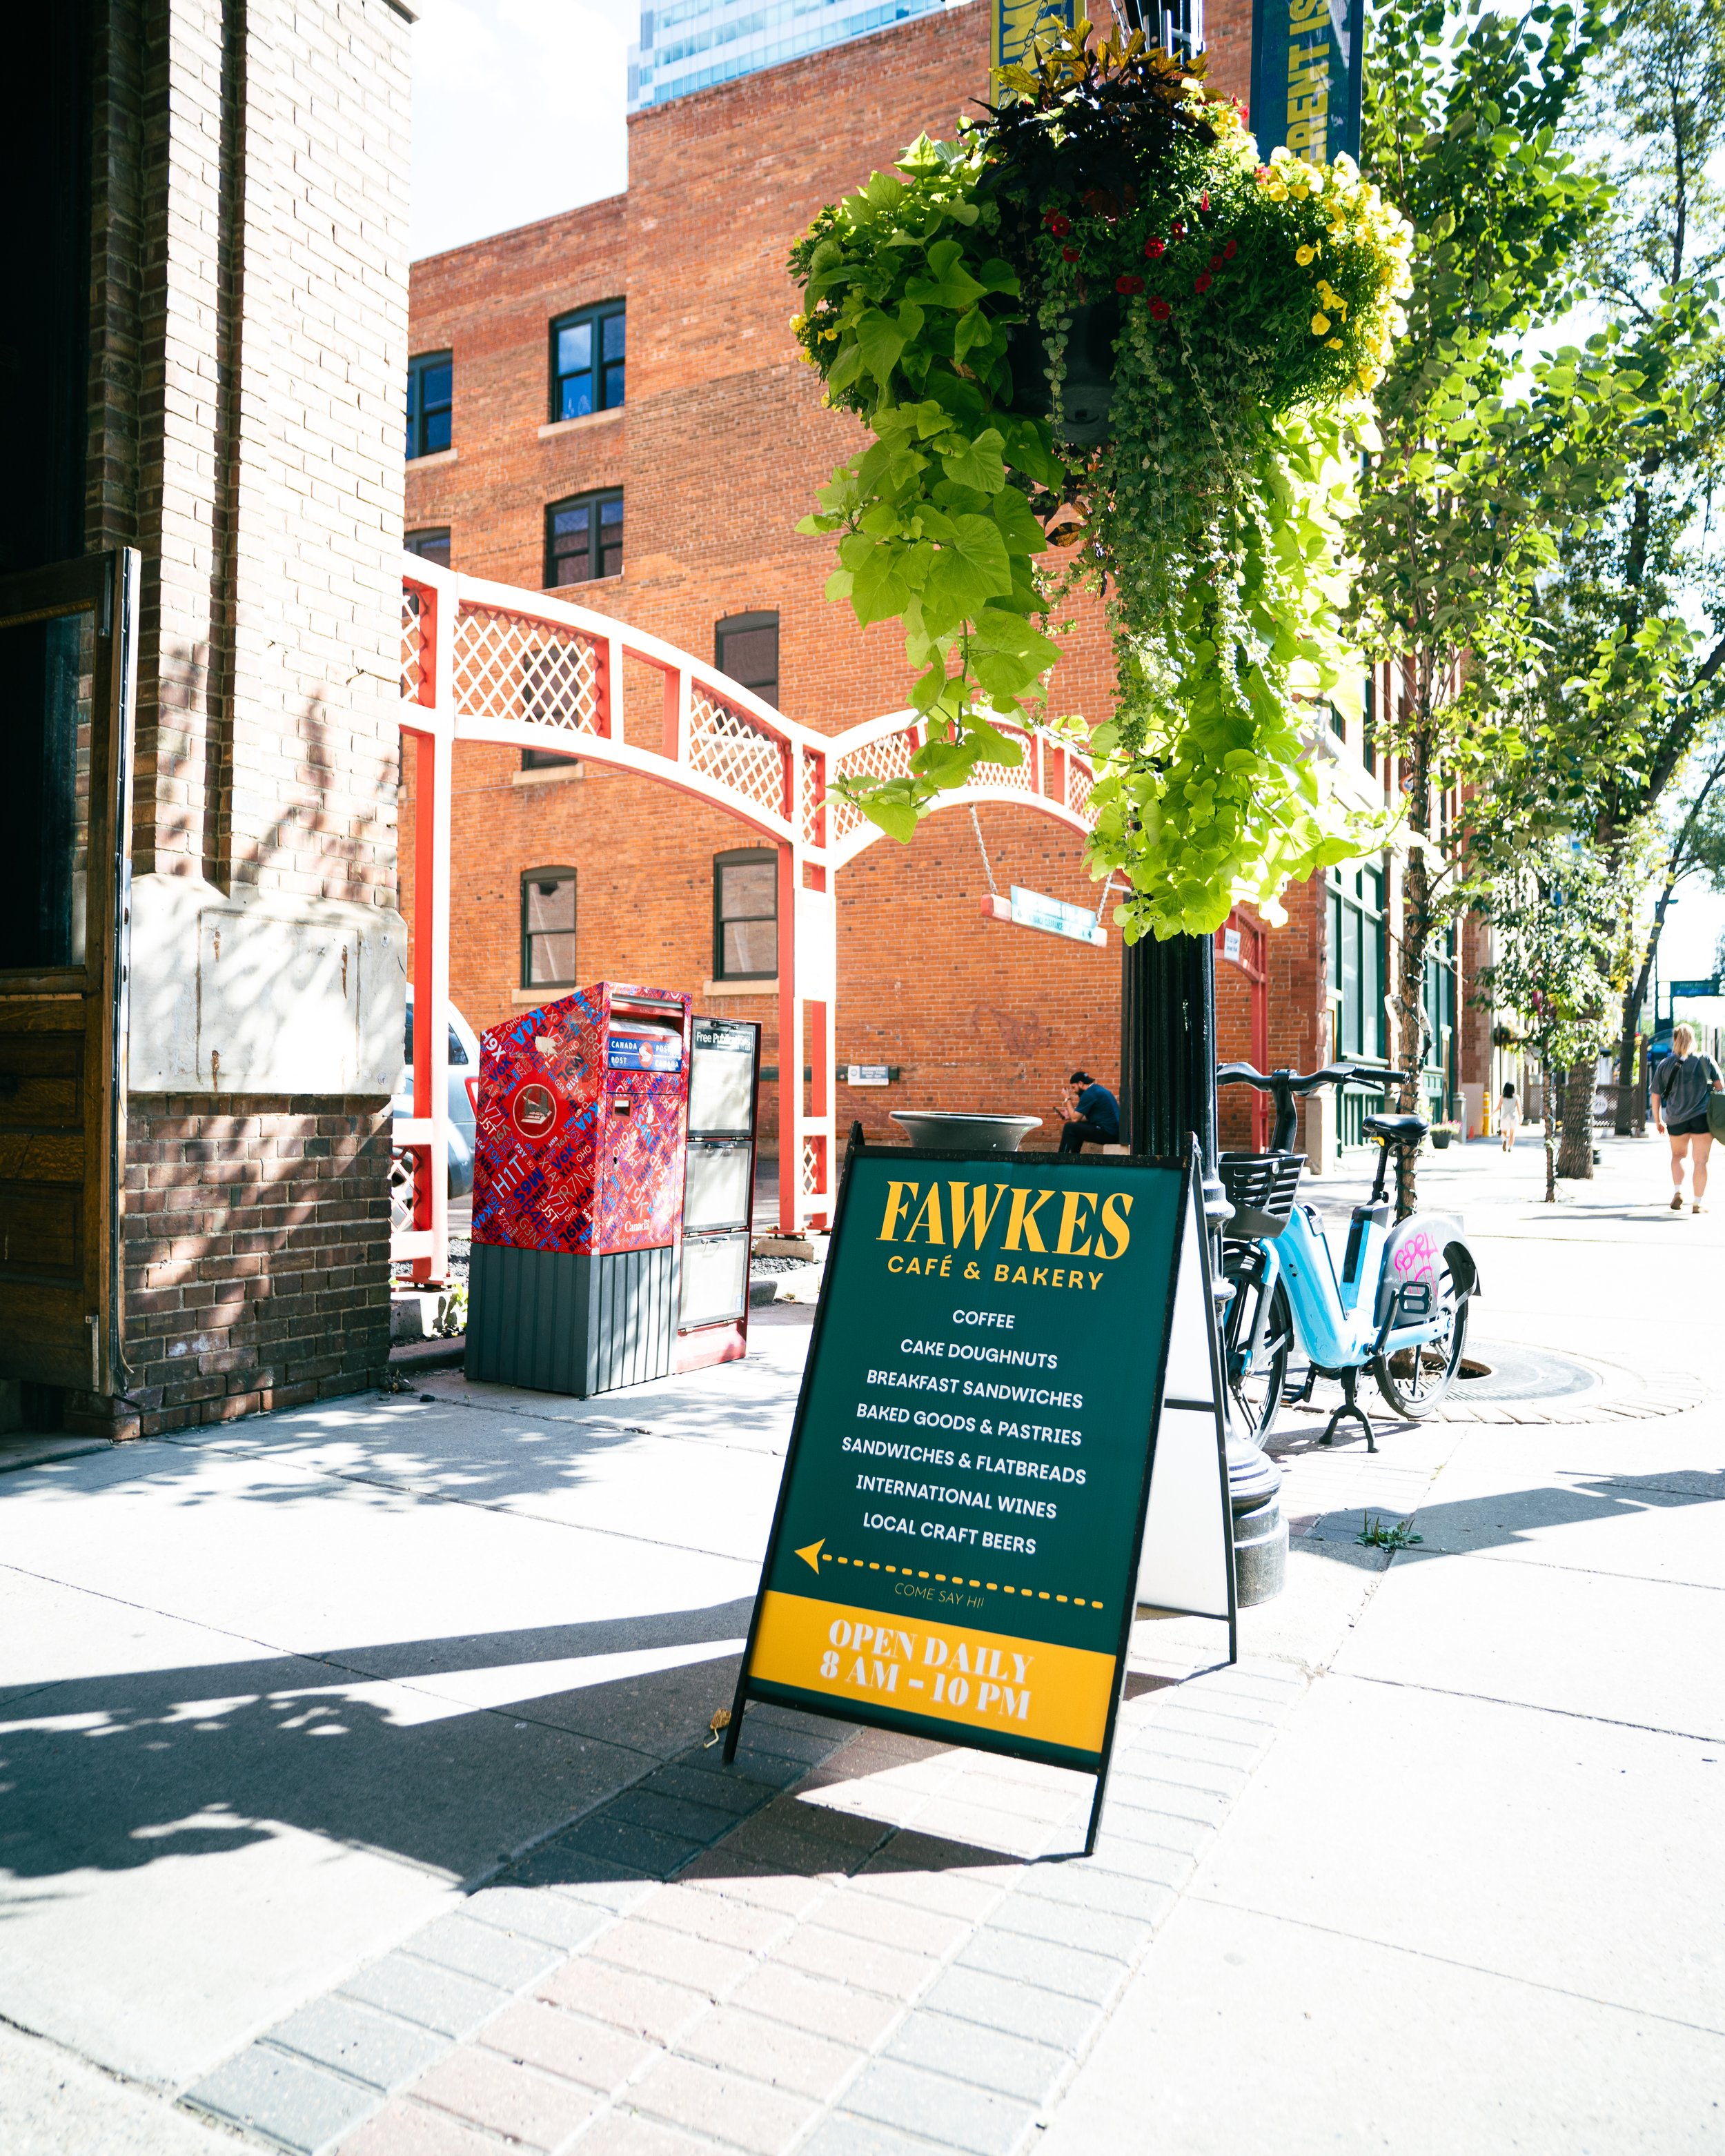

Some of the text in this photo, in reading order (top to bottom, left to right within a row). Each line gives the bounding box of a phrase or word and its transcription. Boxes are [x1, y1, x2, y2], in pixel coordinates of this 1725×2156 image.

[572, 991, 595, 1018] M6S
[492, 1025, 506, 1042] 1A
[511, 1008, 546, 1045] K4A
[554, 1020, 575, 1043] J6W
[696, 1031, 711, 1042] Free
[482, 1029, 506, 1062] H9X
[500, 1037, 520, 1057] J6V
[522, 1040, 544, 1069] B4E
[611, 1041, 638, 1049] CANADA
[484, 1060, 494, 1074] S7P
[489, 1055, 513, 1081] V6K
[514, 1062, 526, 1078] B2Z
[504, 1081, 516, 1096] S4N
[555, 1079, 566, 1093] G5N
[566, 1075, 579, 1090] A1B
[644, 1074, 656, 1091] X1A
[573, 1084, 592, 1109] P9A
[485, 1099, 505, 1127] V7J
[575, 1102, 599, 1131] K4A
[480, 1117, 497, 1135] J5T
[490, 1124, 511, 1144] V9L
[566, 1127, 584, 1144] J6V
[635, 1114, 653, 1147] S4N
[514, 1143, 527, 1158] P3Y
[534, 1144, 549, 1162] T3M
[555, 1134, 571, 1148] V9L
[479, 1154, 495, 1179] T8N
[486, 1143, 504, 1169] T9K
[546, 1148, 556, 1160] S7P
[552, 1143, 577, 1169] V6K
[491, 1154, 524, 1198] H1T
[539, 1157, 557, 1182] X1A
[514, 1167, 544, 1205] M6S
[533, 1183, 548, 1201] E3N
[559, 1166, 591, 1203] R7N
[627, 1174, 649, 1218] T9K
[486, 1188, 502, 1214] T9K
[502, 1196, 520, 1214] J6V
[535, 1198, 546, 1209] Y1A
[547, 1185, 569, 1216] V7J
[572, 1187, 594, 1208] V5A
[472, 1205, 493, 1229] K4A
[498, 1215, 512, 1233] B2Z
[522, 1197, 548, 1233] B4E
[541, 1205, 559, 1222] J5T
[582, 1208, 592, 1222] S4N
[624, 1219, 650, 1232] Canada
[876, 1181, 1133, 1259] FAWKES
[520, 1218, 540, 1245] G3N
[547, 1230, 561, 1250] T9K
[559, 1214, 586, 1242] M9L
[888, 1255, 1103, 1289] CAFÉ & BAKERY
[953, 1310, 1015, 1328] COFFEE
[901, 1339, 1057, 1369] CAKE DOUGHNUTS
[867, 1370, 1083, 1408] BREAKFAST SANDWICHES
[857, 1403, 1081, 1445] BAKED GOODS & PASTRIES
[842, 1437, 1086, 1484] SANDWICHES & FLATBREADS
[856, 1475, 1056, 1519] INTERNATIONAL WINES
[864, 1512, 1036, 1554] LOCAL CRAFT BEERS
[895, 1583, 985, 1608] COME SAY HI!
[829, 1620, 1034, 1684] OPEN DAILY
[820, 1651, 838, 1679] 8
[847, 1656, 899, 1692] AM
[933, 1677, 969, 1706] 10
[976, 1682, 1030, 1720] PM
